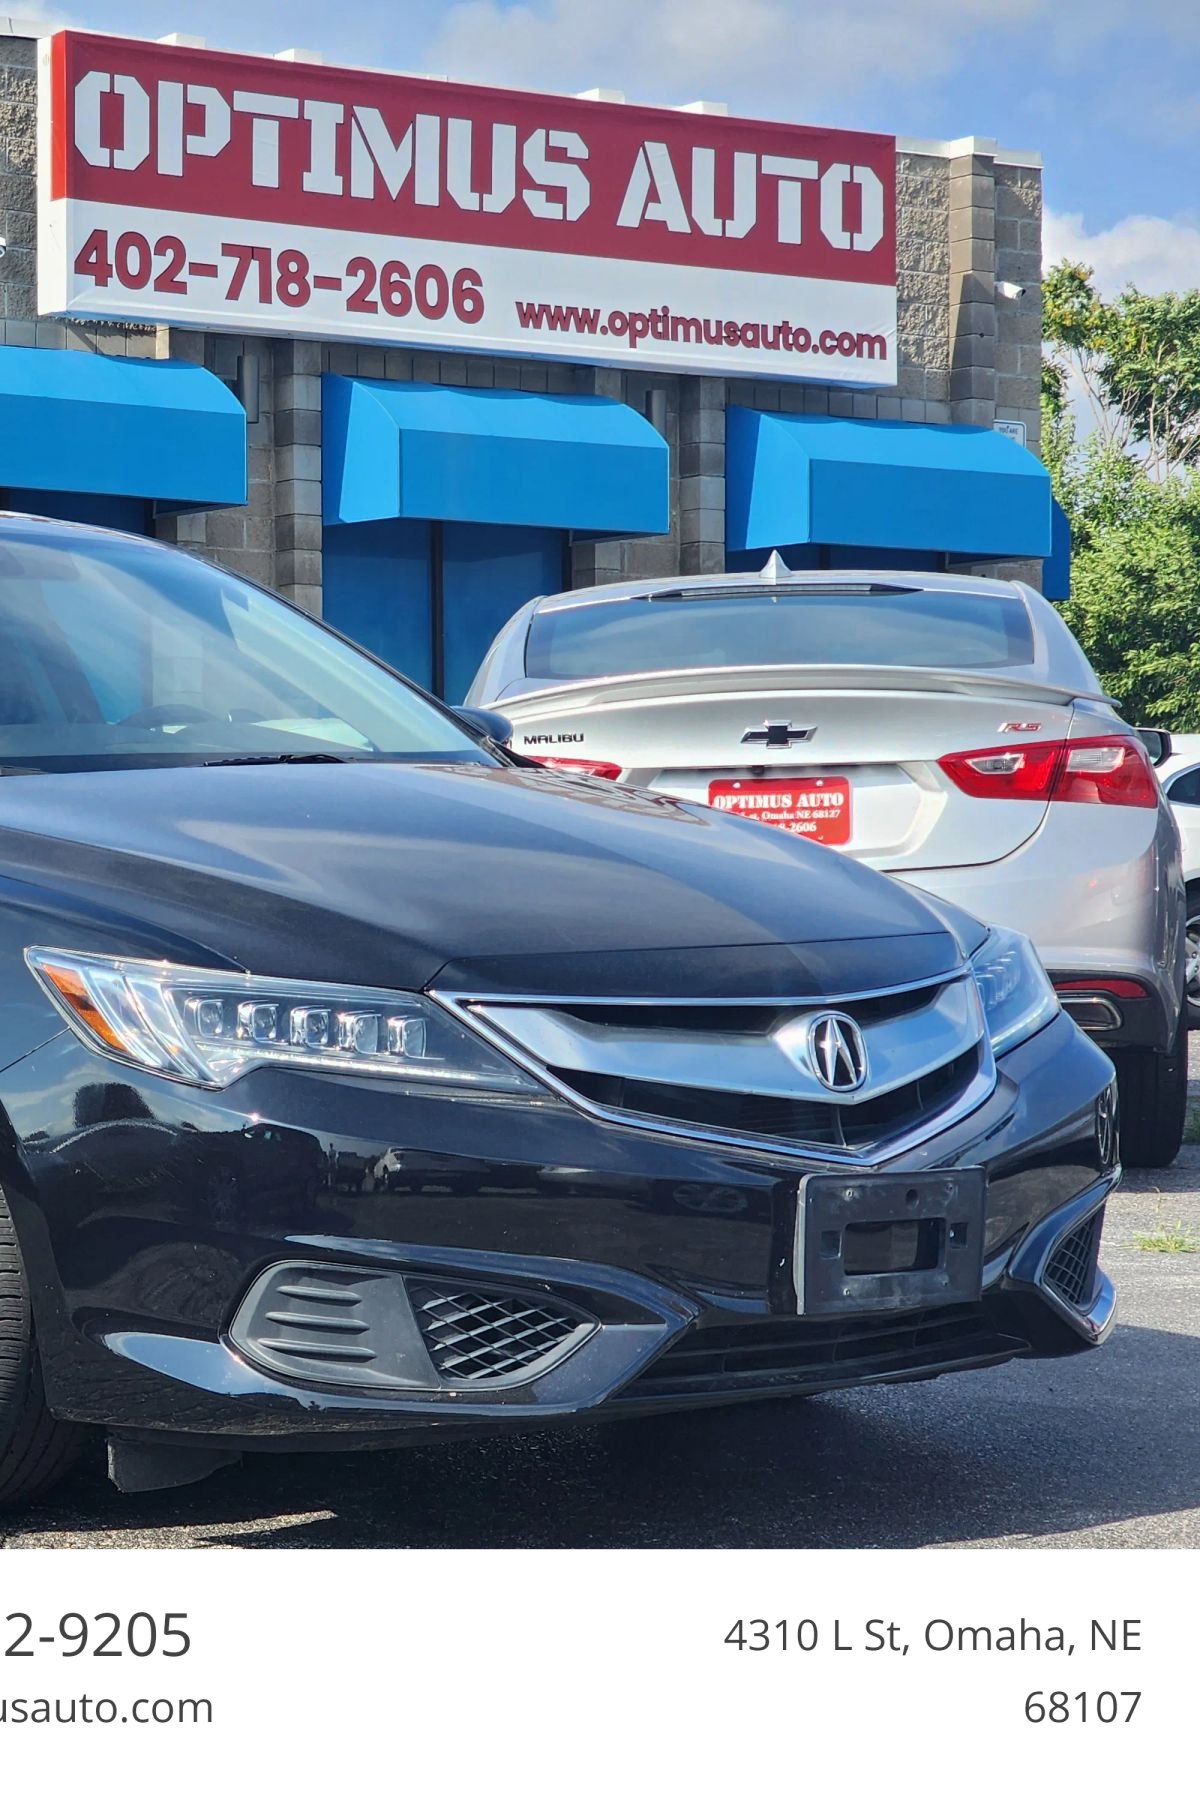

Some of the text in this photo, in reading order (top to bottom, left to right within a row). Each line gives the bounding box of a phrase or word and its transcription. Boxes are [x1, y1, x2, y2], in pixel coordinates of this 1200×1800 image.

[74, 70, 885, 252] OPTIMUS AUTO
[74, 229, 485, 325] 402-718-2606
[516, 301, 887, 361] www.optimusauto.com
[523, 733, 585, 745] MALIBU
[713, 792, 844, 809] OPTIMUS AUTO
[761, 811, 794, 820] Omaha
[796, 811, 811, 819] NE
[812, 809, 840, 818] 68127
